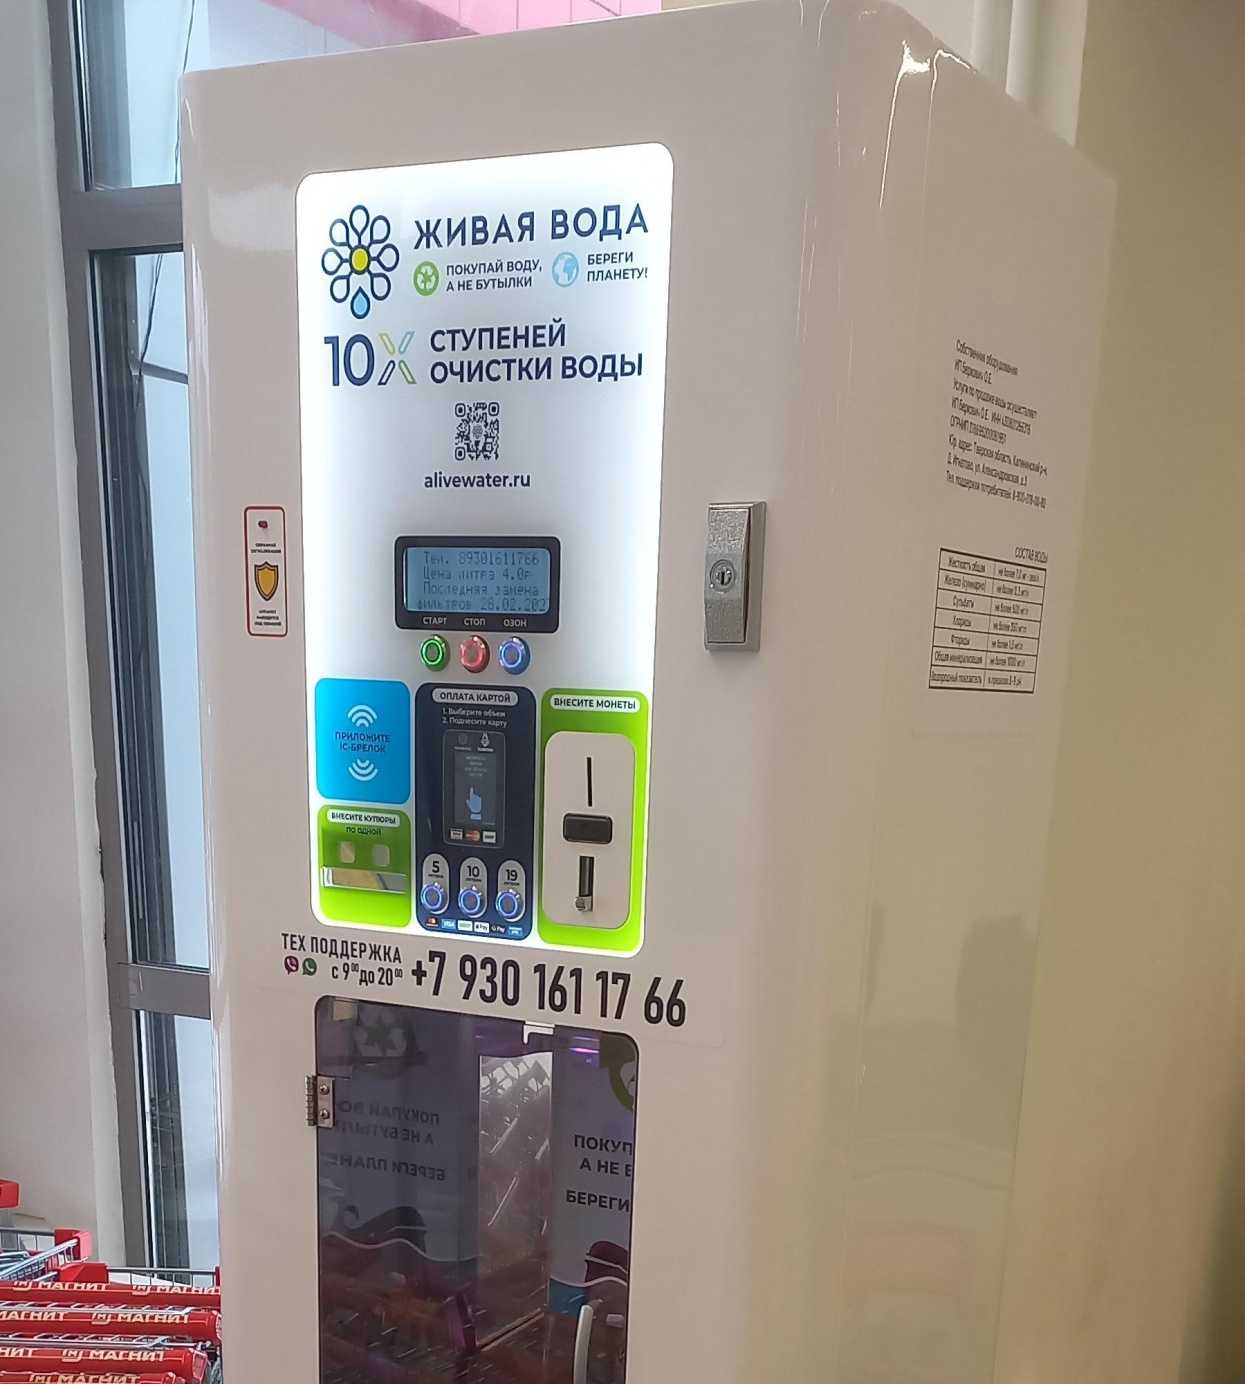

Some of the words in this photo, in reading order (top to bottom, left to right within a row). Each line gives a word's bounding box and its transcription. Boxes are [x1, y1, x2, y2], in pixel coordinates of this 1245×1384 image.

[413, 211, 535, 249] ЖИВАЯ
[550, 203, 648, 241] ВОДА
[587, 252, 634, 265] БЕРЕГИ
[446, 259, 504, 276] ПОКУПАЙ
[507, 258, 542, 273] ВОДУ,
[587, 268, 648, 283] ПЛАНЕТУ!
[446, 280, 455, 292] А
[458, 279, 473, 291] НЕ
[475, 276, 532, 291] БУТЫЛКИ
[430, 318, 566, 353] СТУПЕНЕЙ
[430, 357, 551, 385] ОЧИСТКИ
[561, 353, 643, 382] ВОДЫ
[424, 472, 531, 489] alivewater.ru
[423, 617, 448, 625] СТАРТ
[464, 617, 486, 626] СТОП
[503, 619, 528, 627] ОЗОН
[440, 692, 475, 702] ОПЛАТА
[476, 693, 511, 703] КАРТОЙ
[554, 698, 594, 708] ВНЕСИТЕ
[596, 700, 636, 709] МОНЕТЫ
[448, 707, 482, 717] Выберите
[449, 717, 487, 726] Поднесите
[487, 719, 508, 728] карту
[335, 731, 391, 743] ПРИЛОЖИТЕ
[331, 813, 363, 822] ВНЕСИТЕ
[364, 815, 397, 825] КУПЮРЫ
[432, 860, 440, 873] 5
[466, 865, 480, 877] 10
[505, 869, 518, 881] 19
[281, 933, 306, 952] ТЕХ
[311, 936, 401, 963] ПОДДЕРЖКА
[359, 970, 375, 986] до
[411, 950, 447, 996] +7
[459, 954, 520, 1006] 930
[533, 963, 583, 1015] 161
[596, 970, 631, 1020] 17
[644, 976, 687, 1027] 66
[574, 1134, 632, 1156] ПОКУП
[580, 1157, 591, 1171] А
[597, 1160, 619, 1175] НЕ
[566, 1190, 629, 1212] БЕРЕГИ
[36, 1281, 107, 1292] МАГНИТ
[117, 1313, 189, 1324] МАГНИТ
[89, 1350, 165, 1361] МАГНИТ
